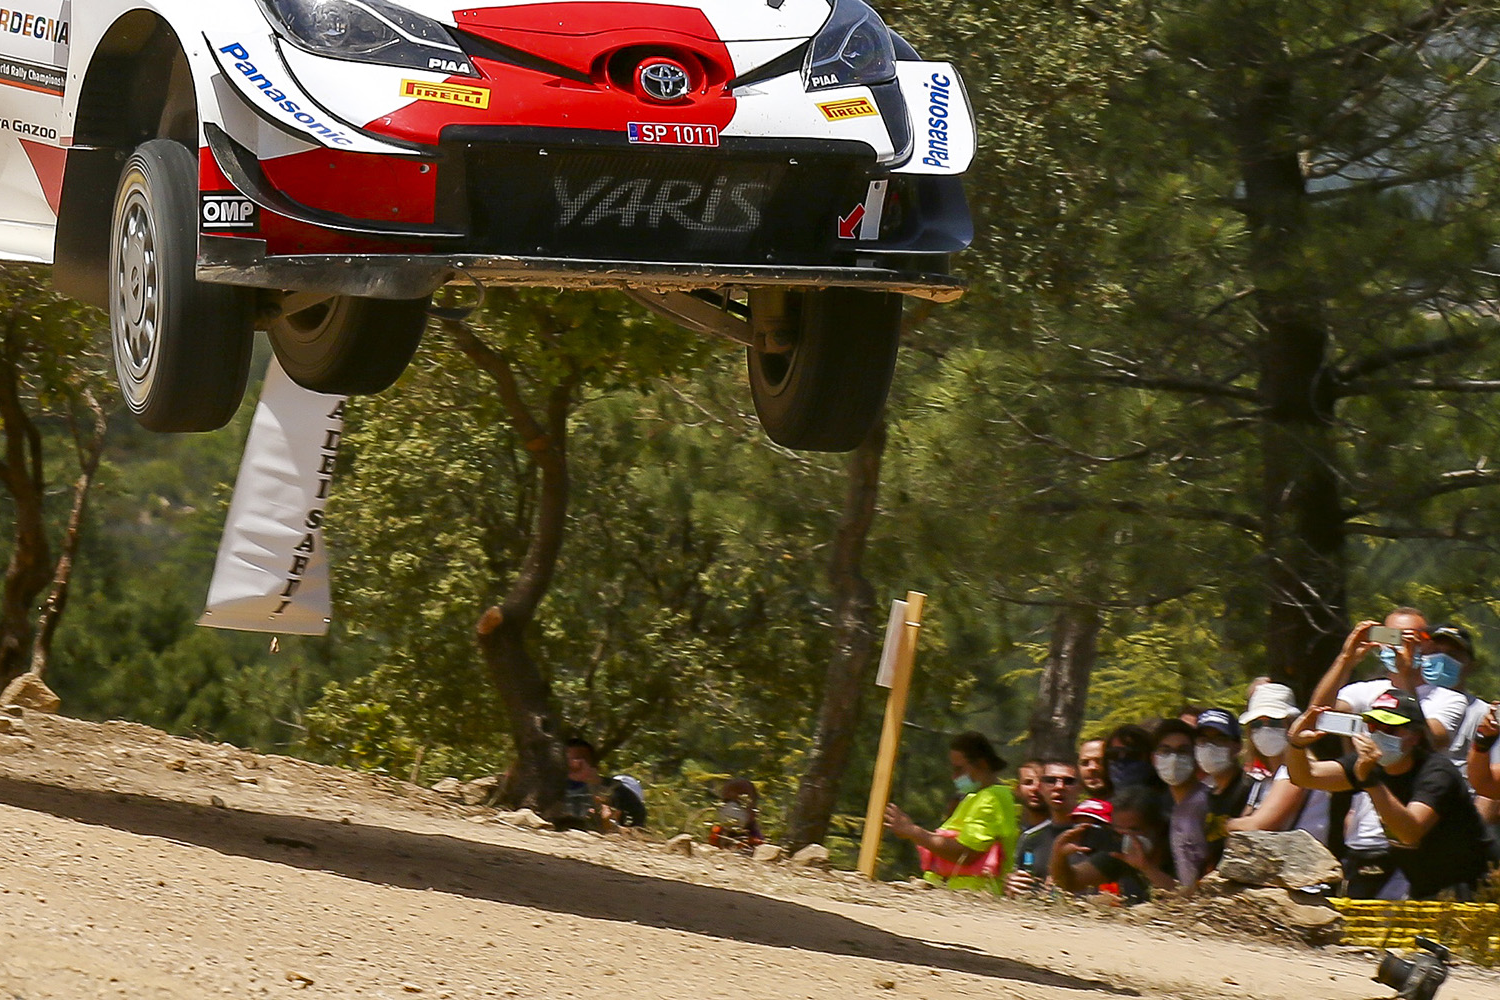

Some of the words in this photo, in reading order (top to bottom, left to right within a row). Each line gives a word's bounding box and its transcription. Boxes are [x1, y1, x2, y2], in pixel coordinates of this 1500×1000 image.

[10, 65, 27, 80] Rally
[428, 57, 471, 74] PIAA
[812, 74, 839, 87] PIAA
[219, 42, 353, 145] Panasonic
[405, 82, 482, 105] PIRELLI
[821, 100, 873, 118] PIRELLI
[13, 120, 57, 139] GAZOO
[923, 72, 951, 169] Panasonic
[642, 125, 667, 142] SP
[673, 126, 713, 144] 1011
[203, 201, 254, 222] OMP
